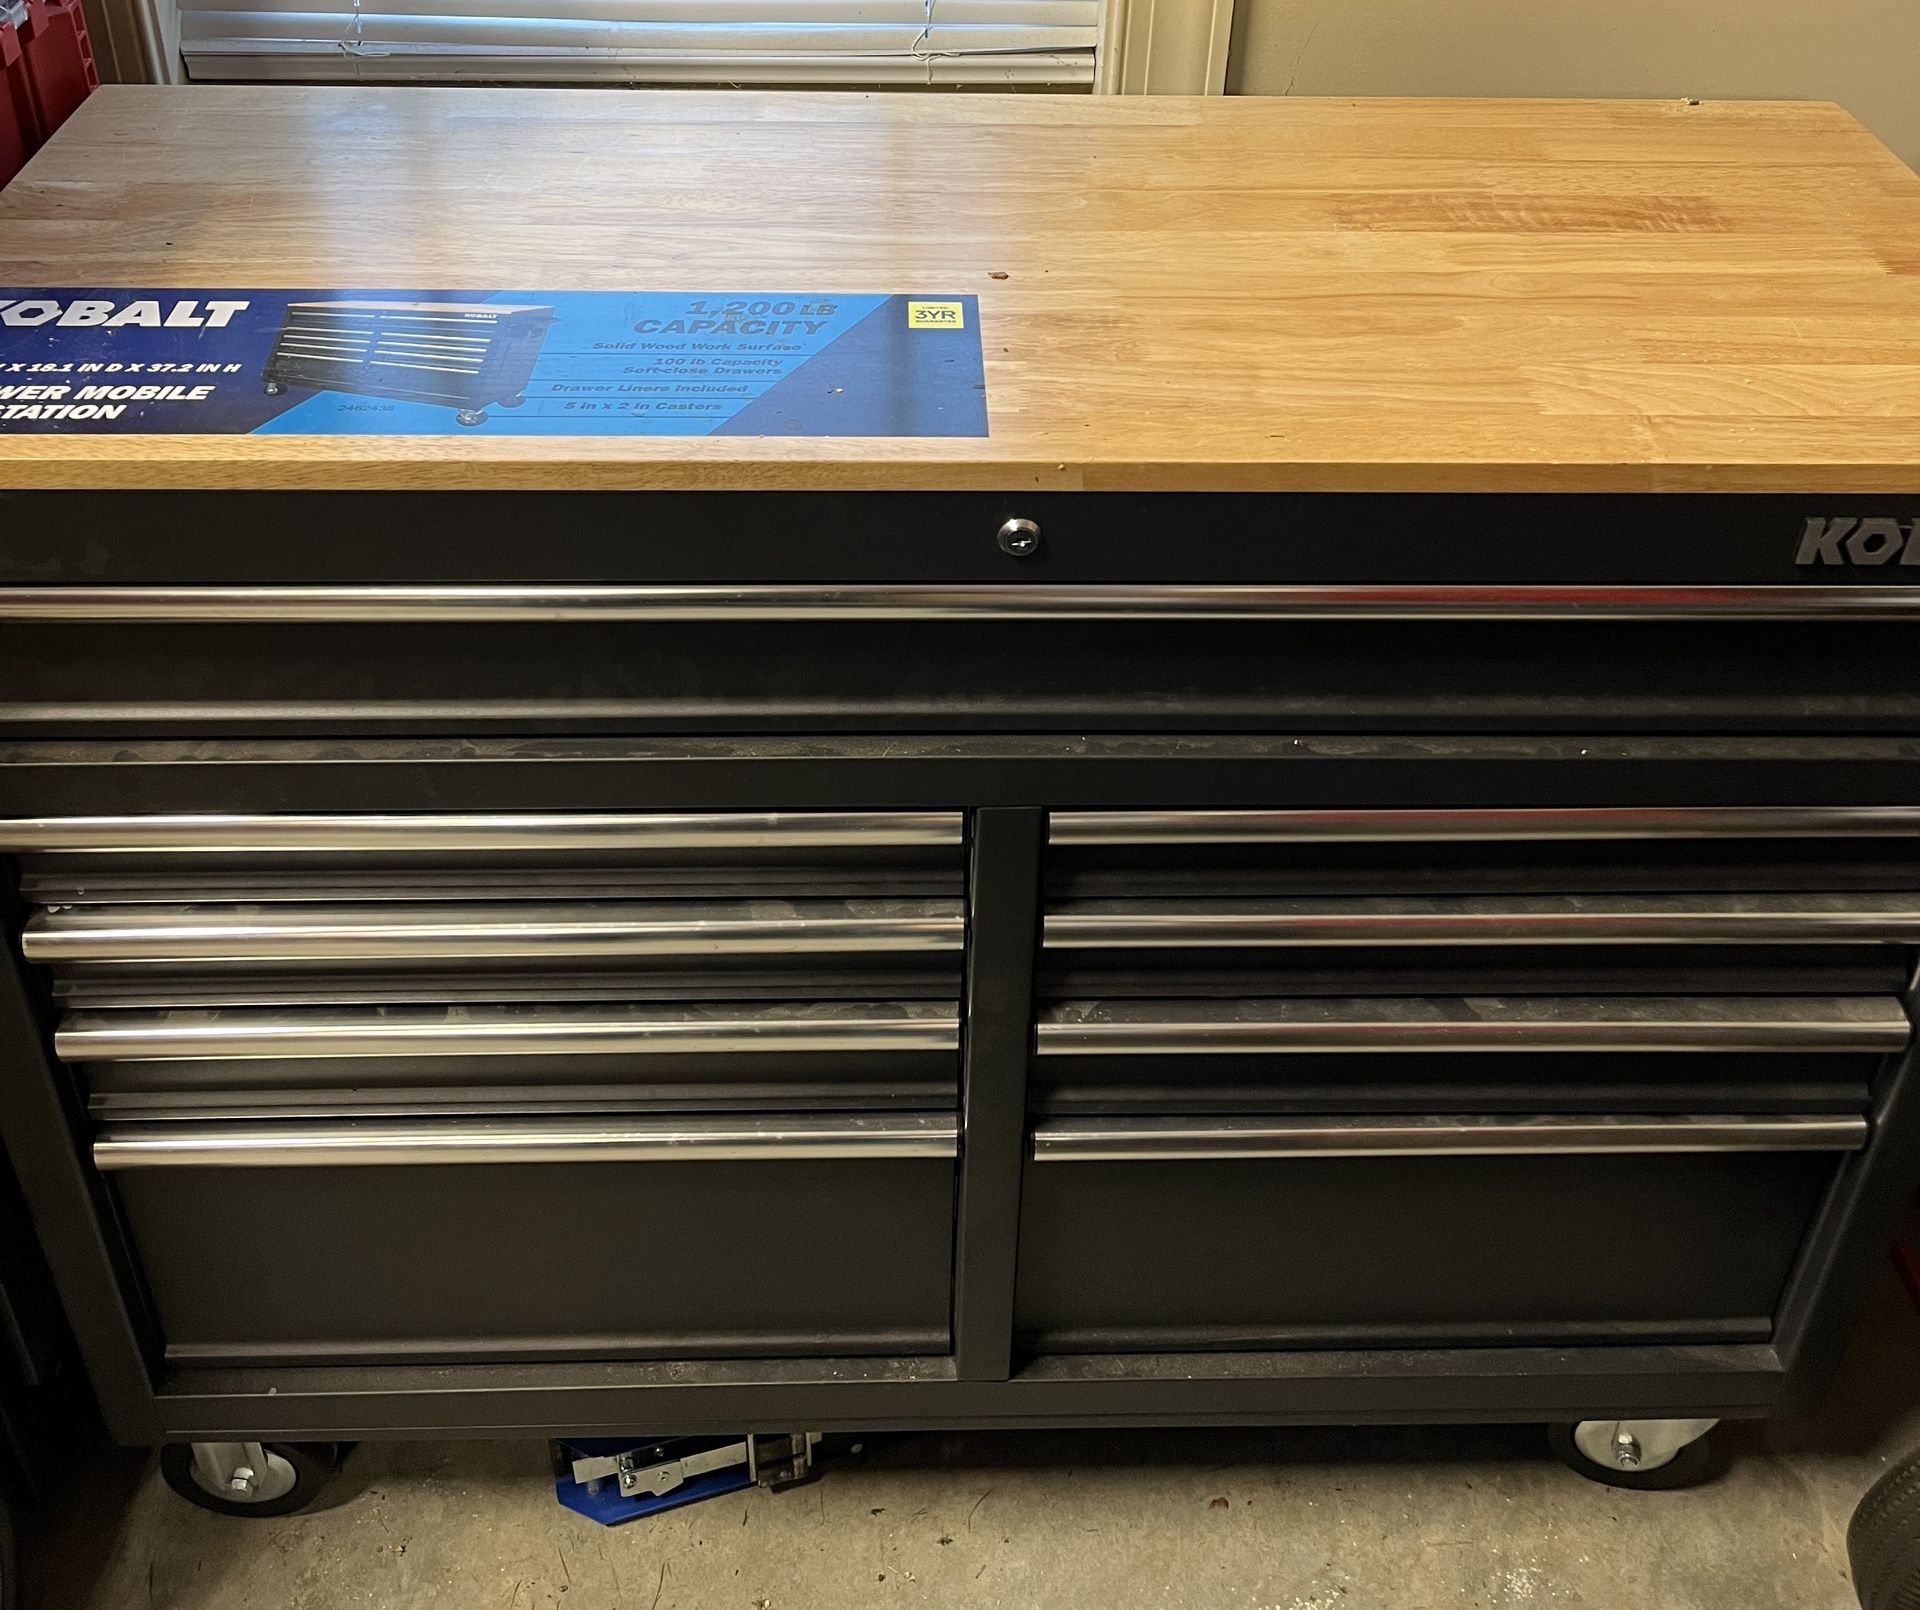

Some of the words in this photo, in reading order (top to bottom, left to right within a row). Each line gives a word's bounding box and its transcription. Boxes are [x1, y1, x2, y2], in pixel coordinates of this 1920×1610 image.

[684, 301, 796, 318] 1,200
[800, 303, 839, 316] LB
[915, 310, 956, 319] 3YR
[633, 319, 829, 335] CAPACITY
[593, 342, 635, 350] Solid
[641, 342, 686, 350] Wood
[736, 343, 802, 351] Surface
[711, 358, 783, 367] Capacity
[4, 363, 27, 372] X
[25, 363, 74, 372] 18.1
[77, 363, 104, 372] IN
[104, 363, 123, 372] D
[124, 363, 146, 372] X
[146, 363, 194, 372] 37.2
[195, 363, 222, 372] IN
[222, 363, 242, 372] H
[623, 366, 709, 374] Soft-close
[713, 367, 782, 375] Drawers
[73, 385, 216, 400] MOBILE
[551, 384, 613, 392] Drawer
[617, 384, 670, 392] Liners
[674, 384, 749, 392] Included
[564, 402, 577, 410] 5
[580, 402, 597, 410] in
[618, 402, 630, 410] 2
[634, 402, 650, 410] in
[655, 402, 722, 410] Casters
